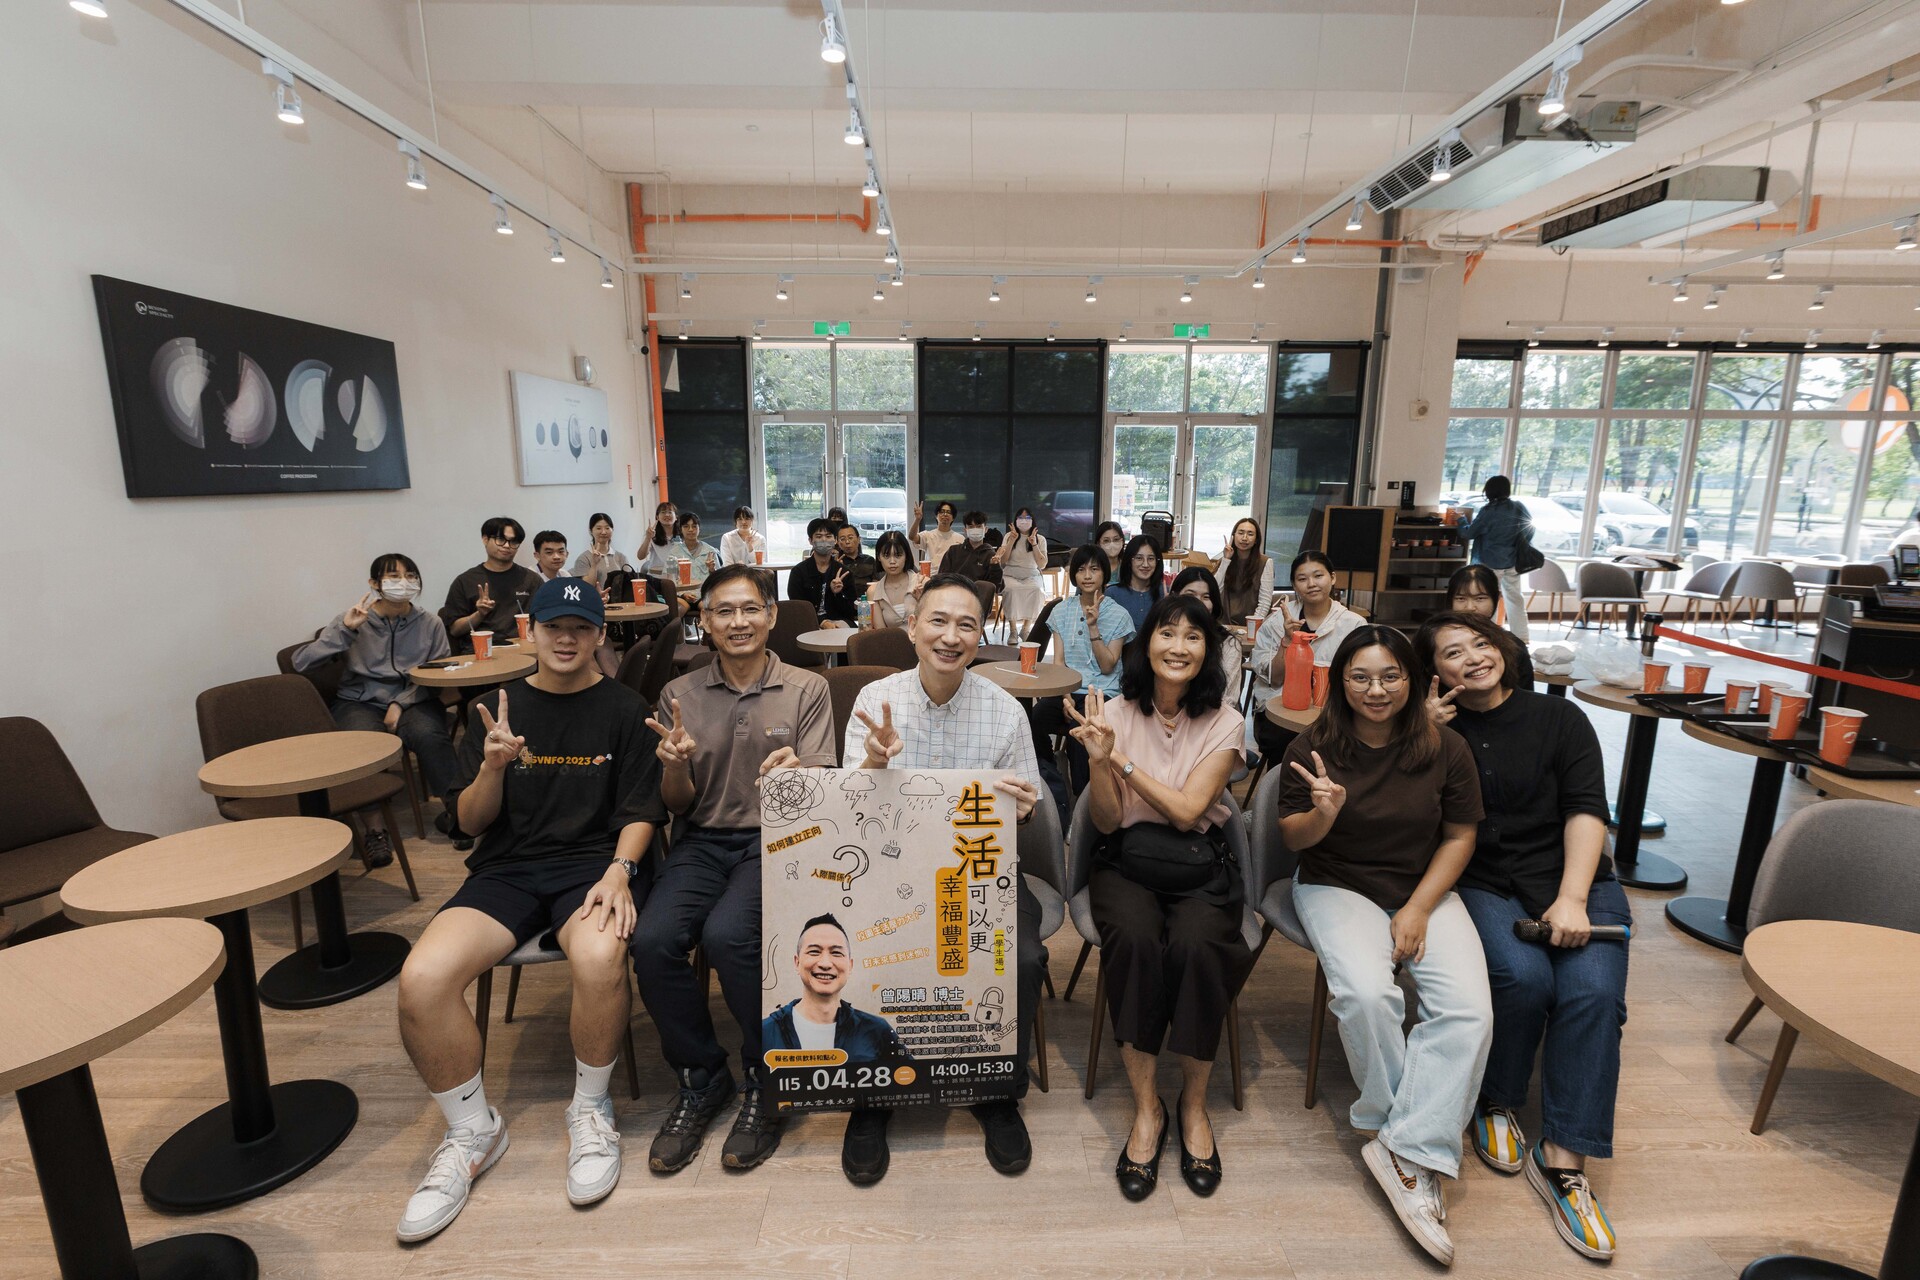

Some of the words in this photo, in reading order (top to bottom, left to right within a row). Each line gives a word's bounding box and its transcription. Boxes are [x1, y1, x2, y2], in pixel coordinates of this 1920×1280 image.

[563, 584, 581, 602] NY
[565, 756, 592, 766] 2023
[766, 825, 822, 854] 如何建立正向
[953, 782, 1002, 880] 生活
[940, 874, 965, 971] 幸福豐盛
[968, 884, 991, 953] 可以更
[881, 987, 927, 1003] 曾陽晴
[933, 986, 965, 1002] 博士
[930, 1060, 1014, 1077] 14:00-15:30
[779, 1077, 801, 1091] 115
